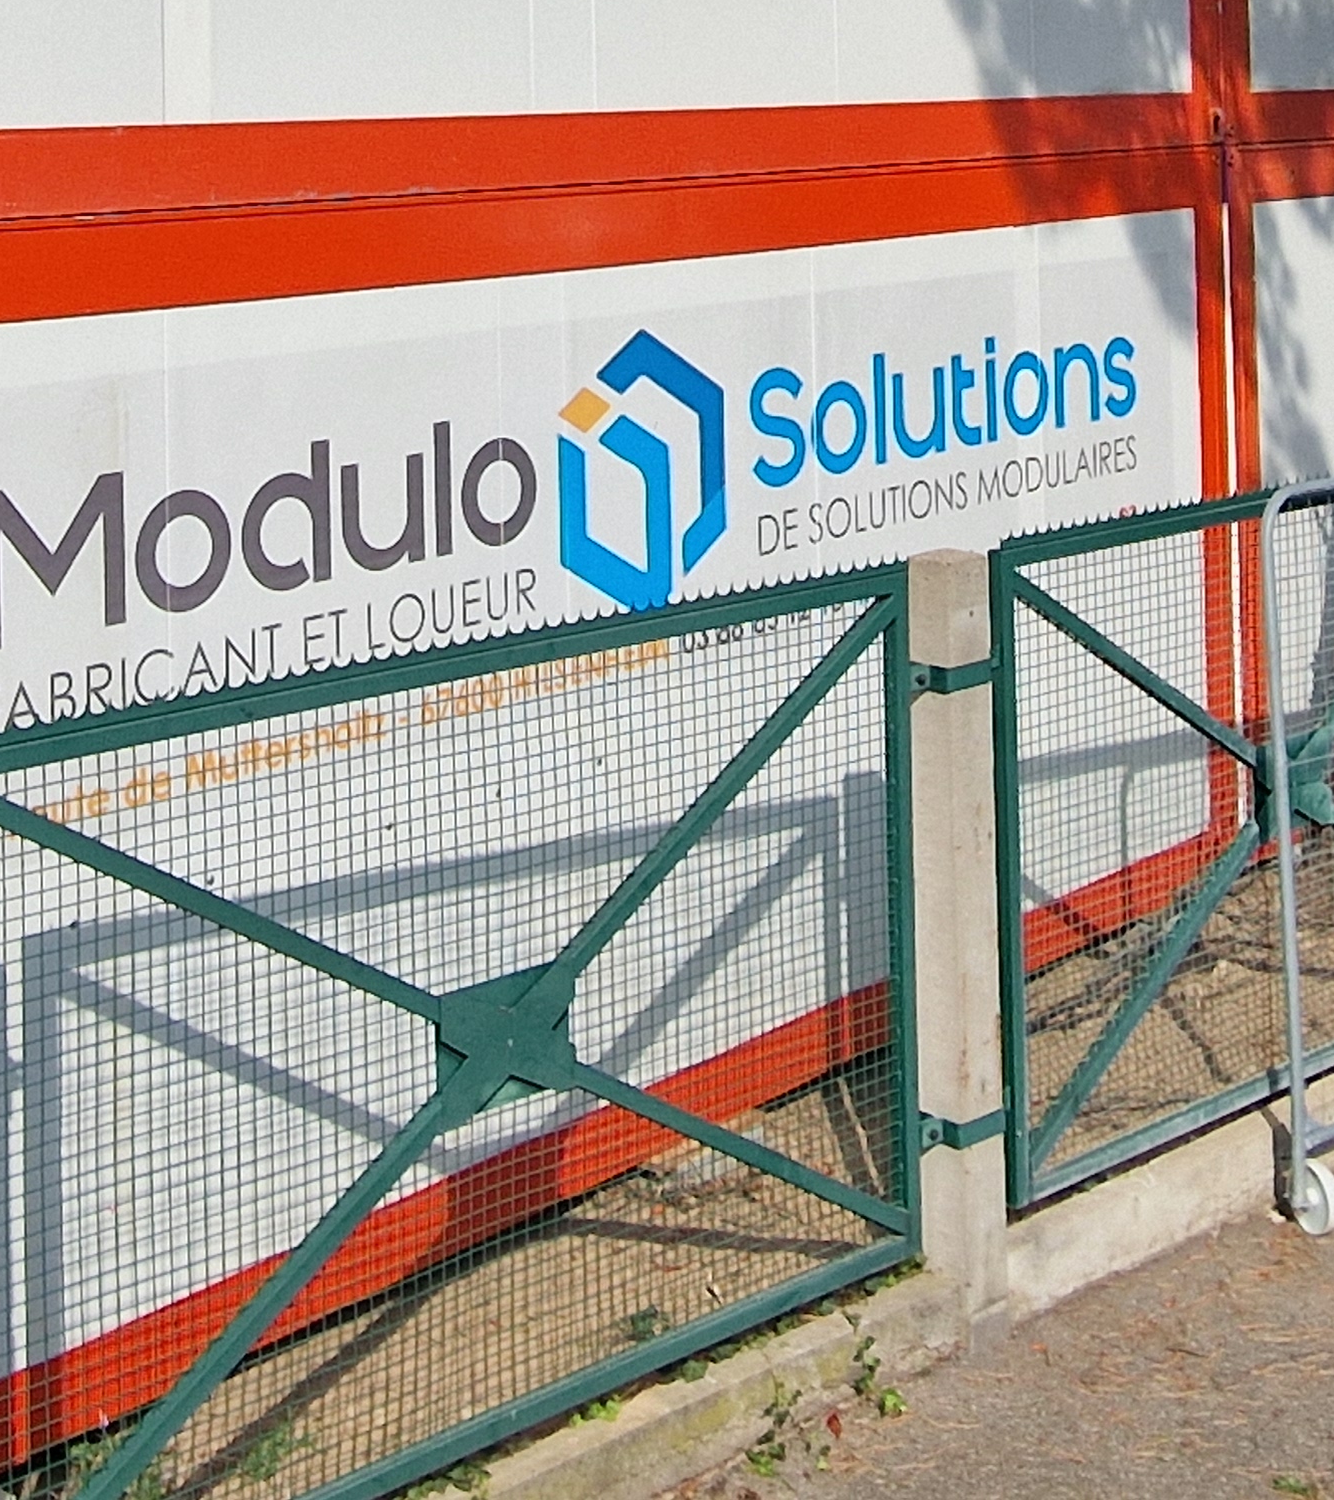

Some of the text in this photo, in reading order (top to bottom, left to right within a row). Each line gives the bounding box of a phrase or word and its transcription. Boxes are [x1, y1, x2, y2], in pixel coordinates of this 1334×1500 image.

[749, 335, 1137, 488] Solutions
[303, 609, 348, 666] ET
[366, 567, 538, 652] LOUEUR
[757, 508, 801, 556] DE
[809, 472, 968, 544] SOLUTIONS
[976, 434, 1138, 499] MODULAIRES
[124, 766, 171, 808] de
